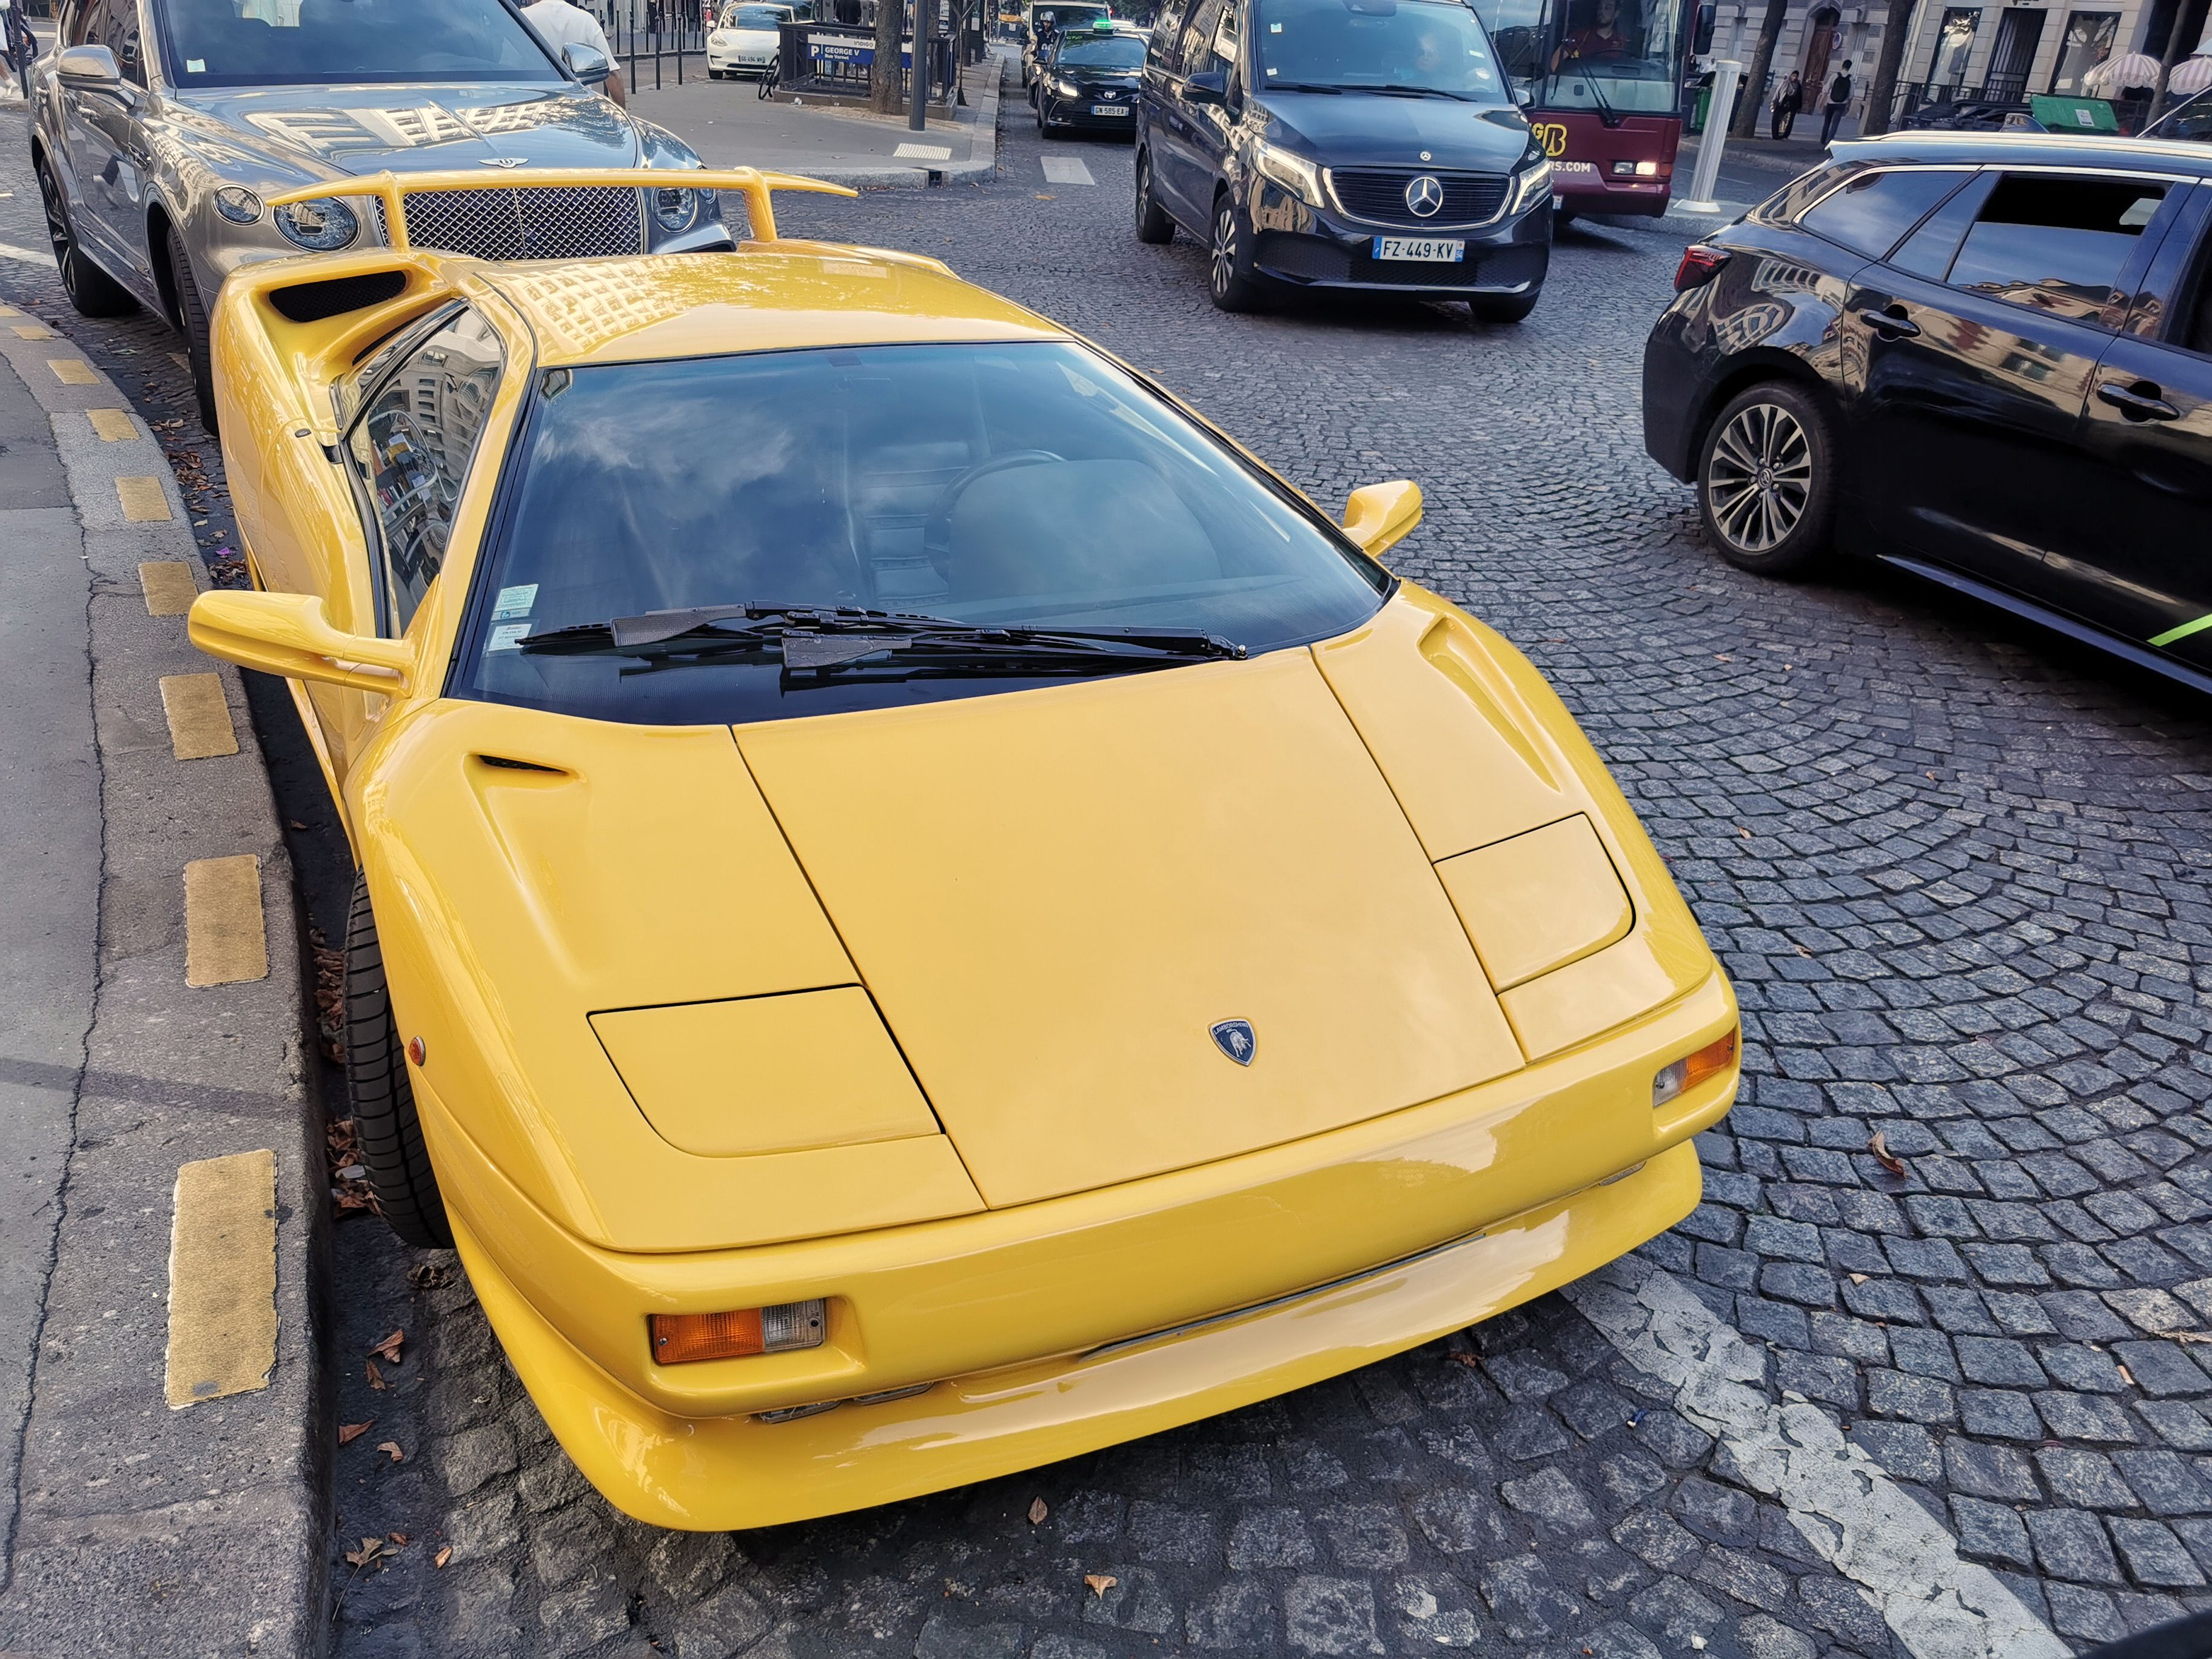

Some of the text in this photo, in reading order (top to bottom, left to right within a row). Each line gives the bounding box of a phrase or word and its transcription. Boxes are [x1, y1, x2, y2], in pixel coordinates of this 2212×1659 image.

[811, 45, 820, 57] P
[825, 47, 853, 56] GEORGE
[1383, 241, 1453, 259] FZ-449-KV
[1213, 1022, 1248, 1034] LAMBORGHINI
